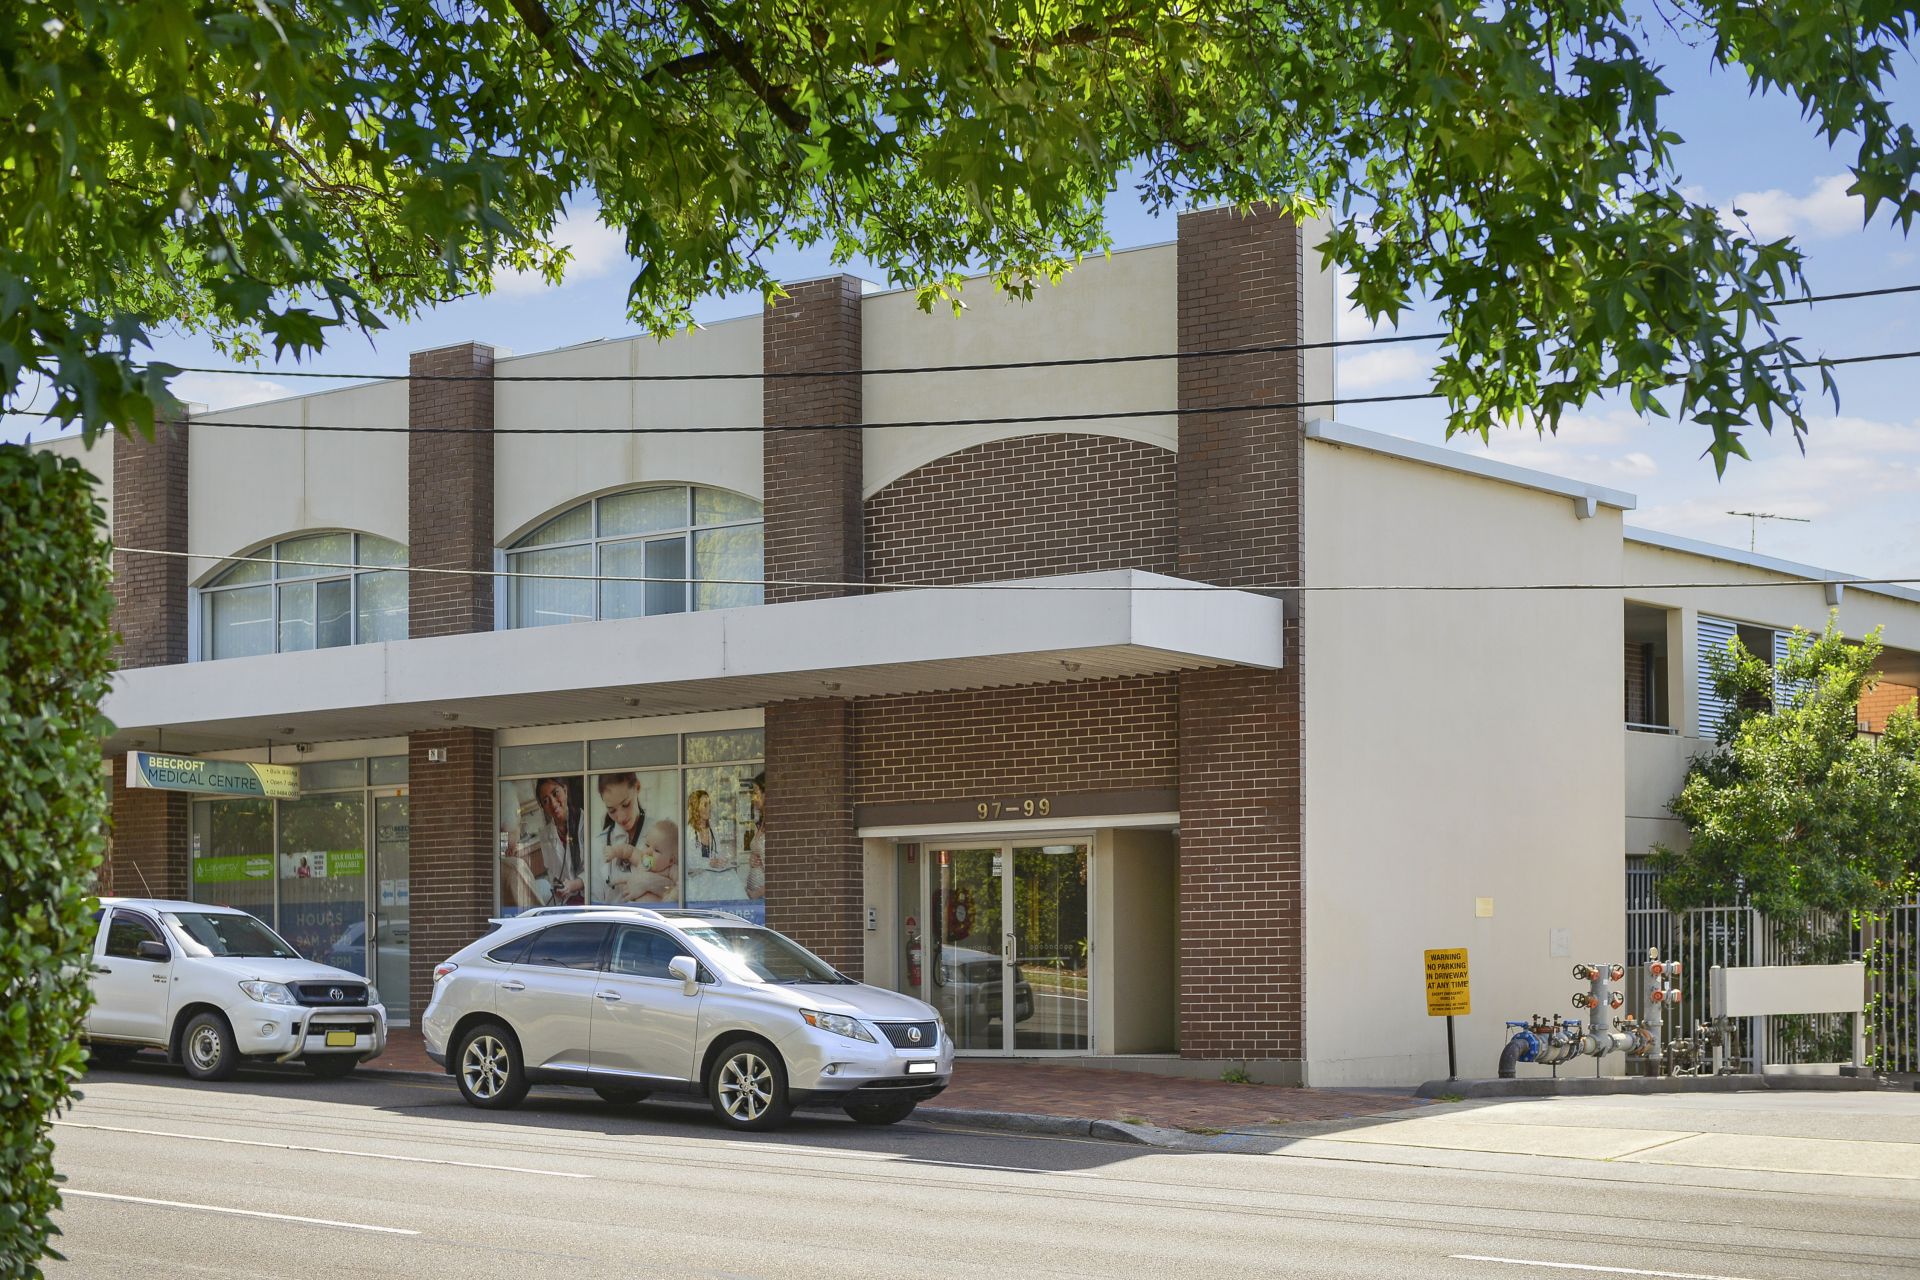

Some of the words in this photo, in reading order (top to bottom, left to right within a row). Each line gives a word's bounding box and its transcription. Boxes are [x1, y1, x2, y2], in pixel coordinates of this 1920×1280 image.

[149, 756, 205, 772] BEECROFT
[148, 768, 204, 786] MEDICAL
[208, 774, 257, 790] CENTRE
[977, 798, 1050, 820] 97-99
[335, 860, 361, 868] AVAILABLE
[296, 912, 343, 926] HOURS
[296, 935, 319, 947] 9AM
[331, 955, 352, 968] 5PM
[1431, 953, 1461, 961] WARNING
[1427, 963, 1436, 971] NO
[1437, 961, 1467, 970] PARKING
[1434, 971, 1468, 980] DRIVEWAY
[1436, 981, 1450, 989] ANY
[1451, 980, 1469, 988] TIME
